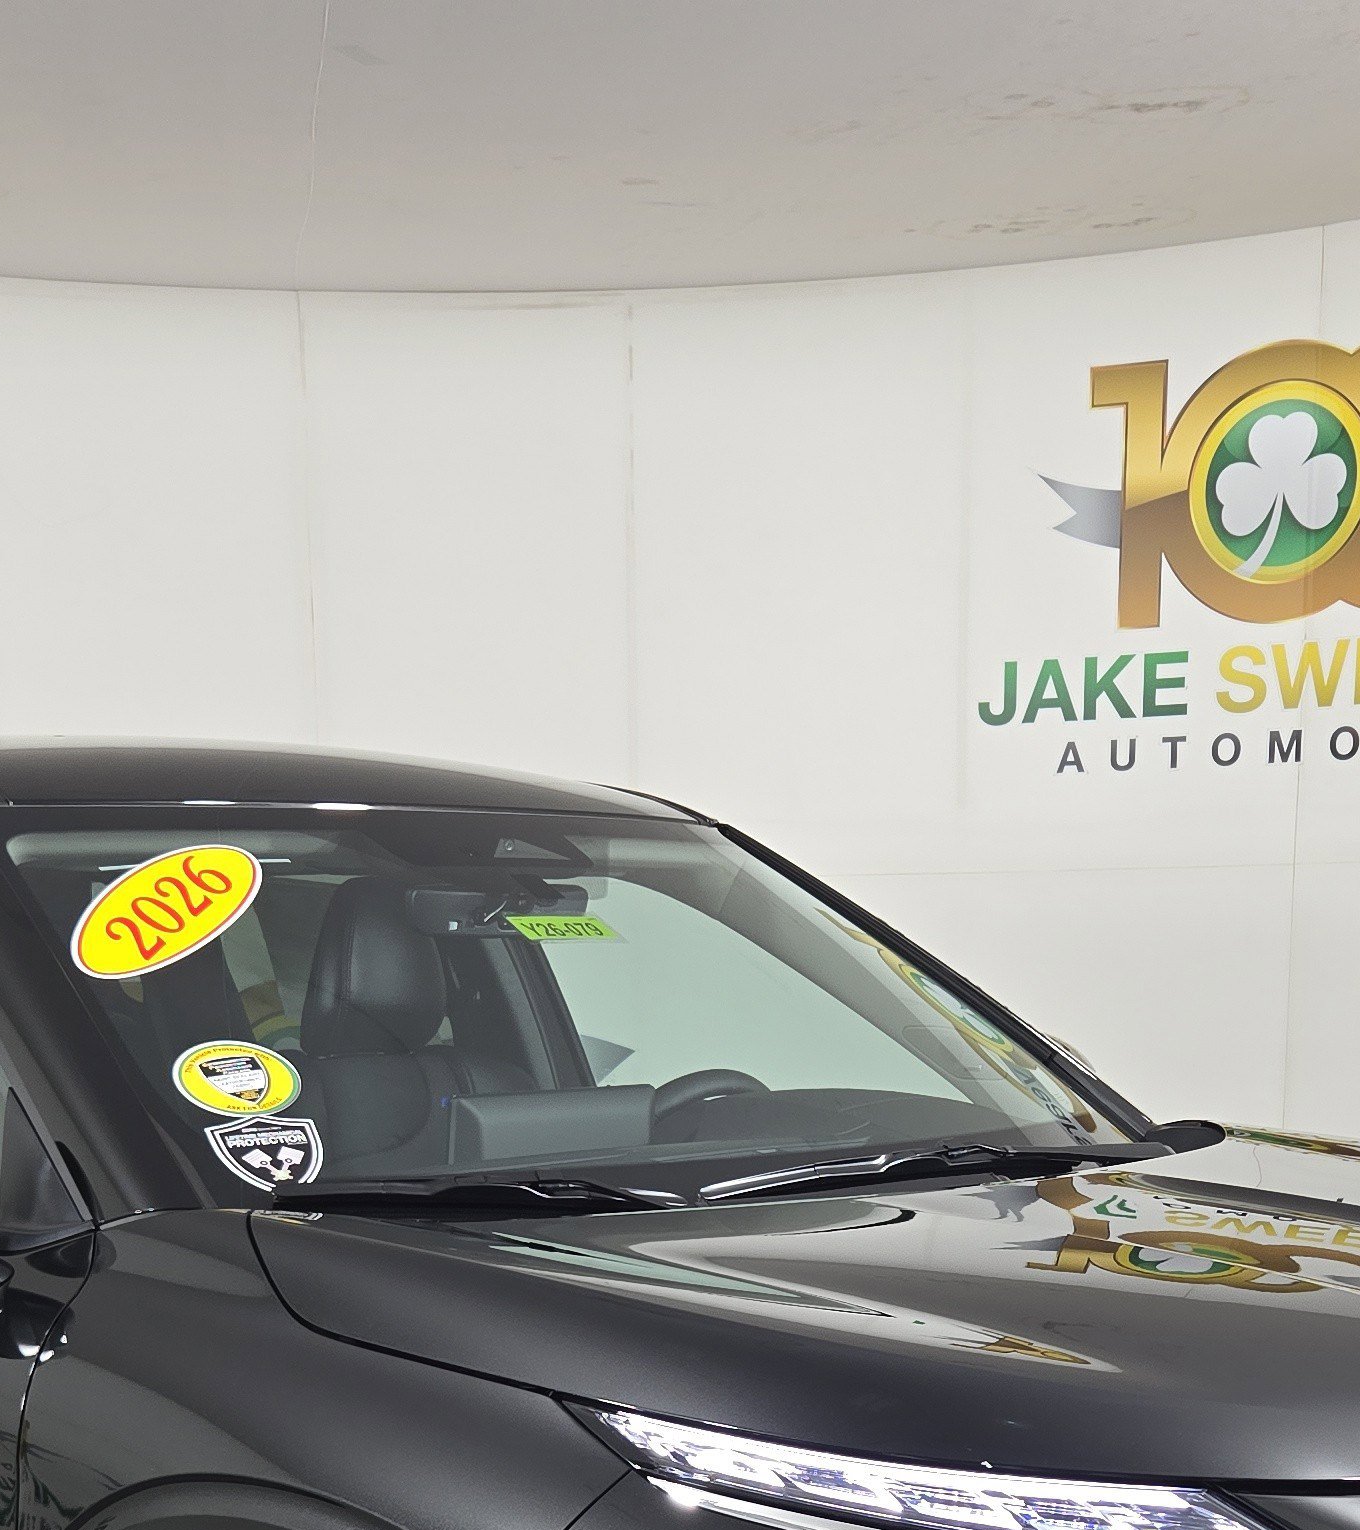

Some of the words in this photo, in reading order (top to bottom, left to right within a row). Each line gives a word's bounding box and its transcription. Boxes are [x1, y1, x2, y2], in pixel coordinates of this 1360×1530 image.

[977, 650, 1189, 726] JAKE
[105, 856, 232, 960] 2026
[521, 923, 604, 937] Y26-079
[226, 1134, 308, 1148] PROTECTION
